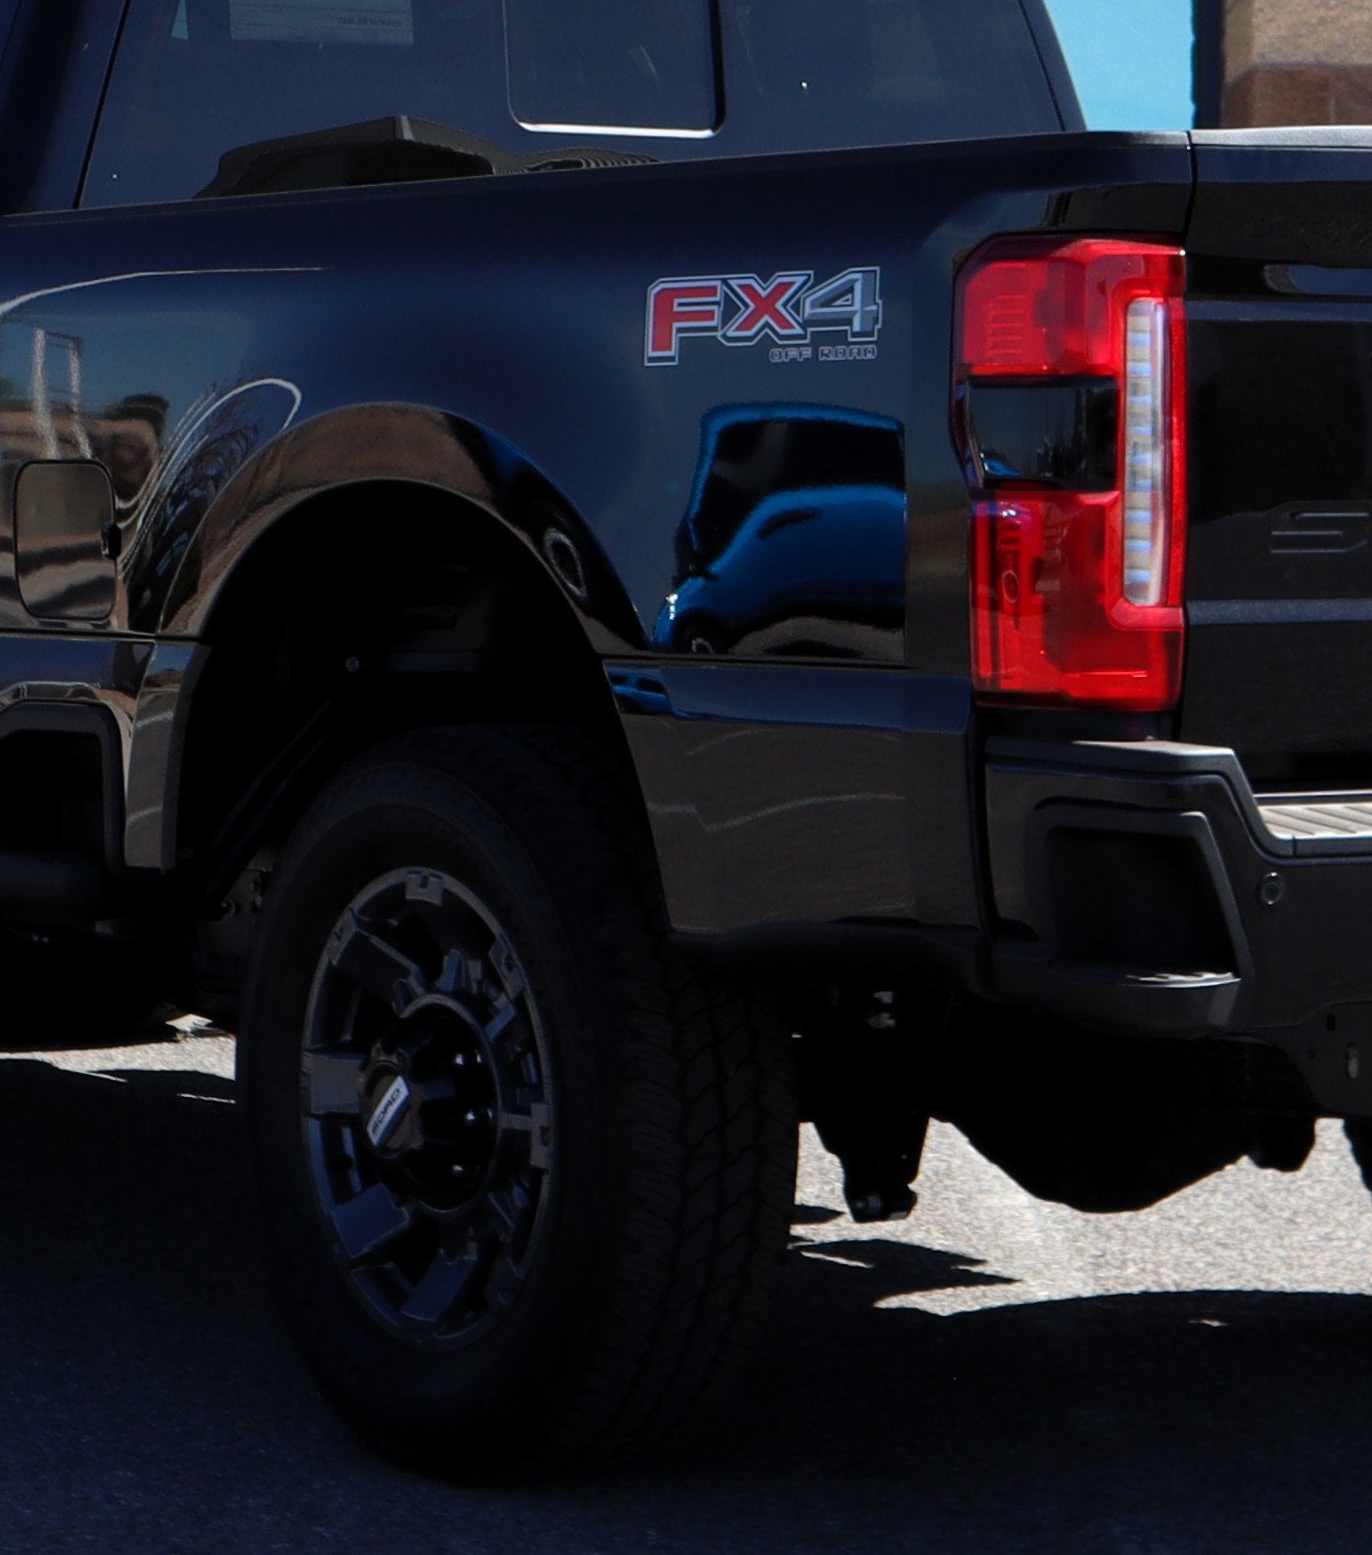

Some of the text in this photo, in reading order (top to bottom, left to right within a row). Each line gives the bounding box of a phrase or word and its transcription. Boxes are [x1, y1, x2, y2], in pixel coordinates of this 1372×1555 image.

[644, 266, 882, 366] FX4
[769, 345, 877, 363] OFF ROAD
